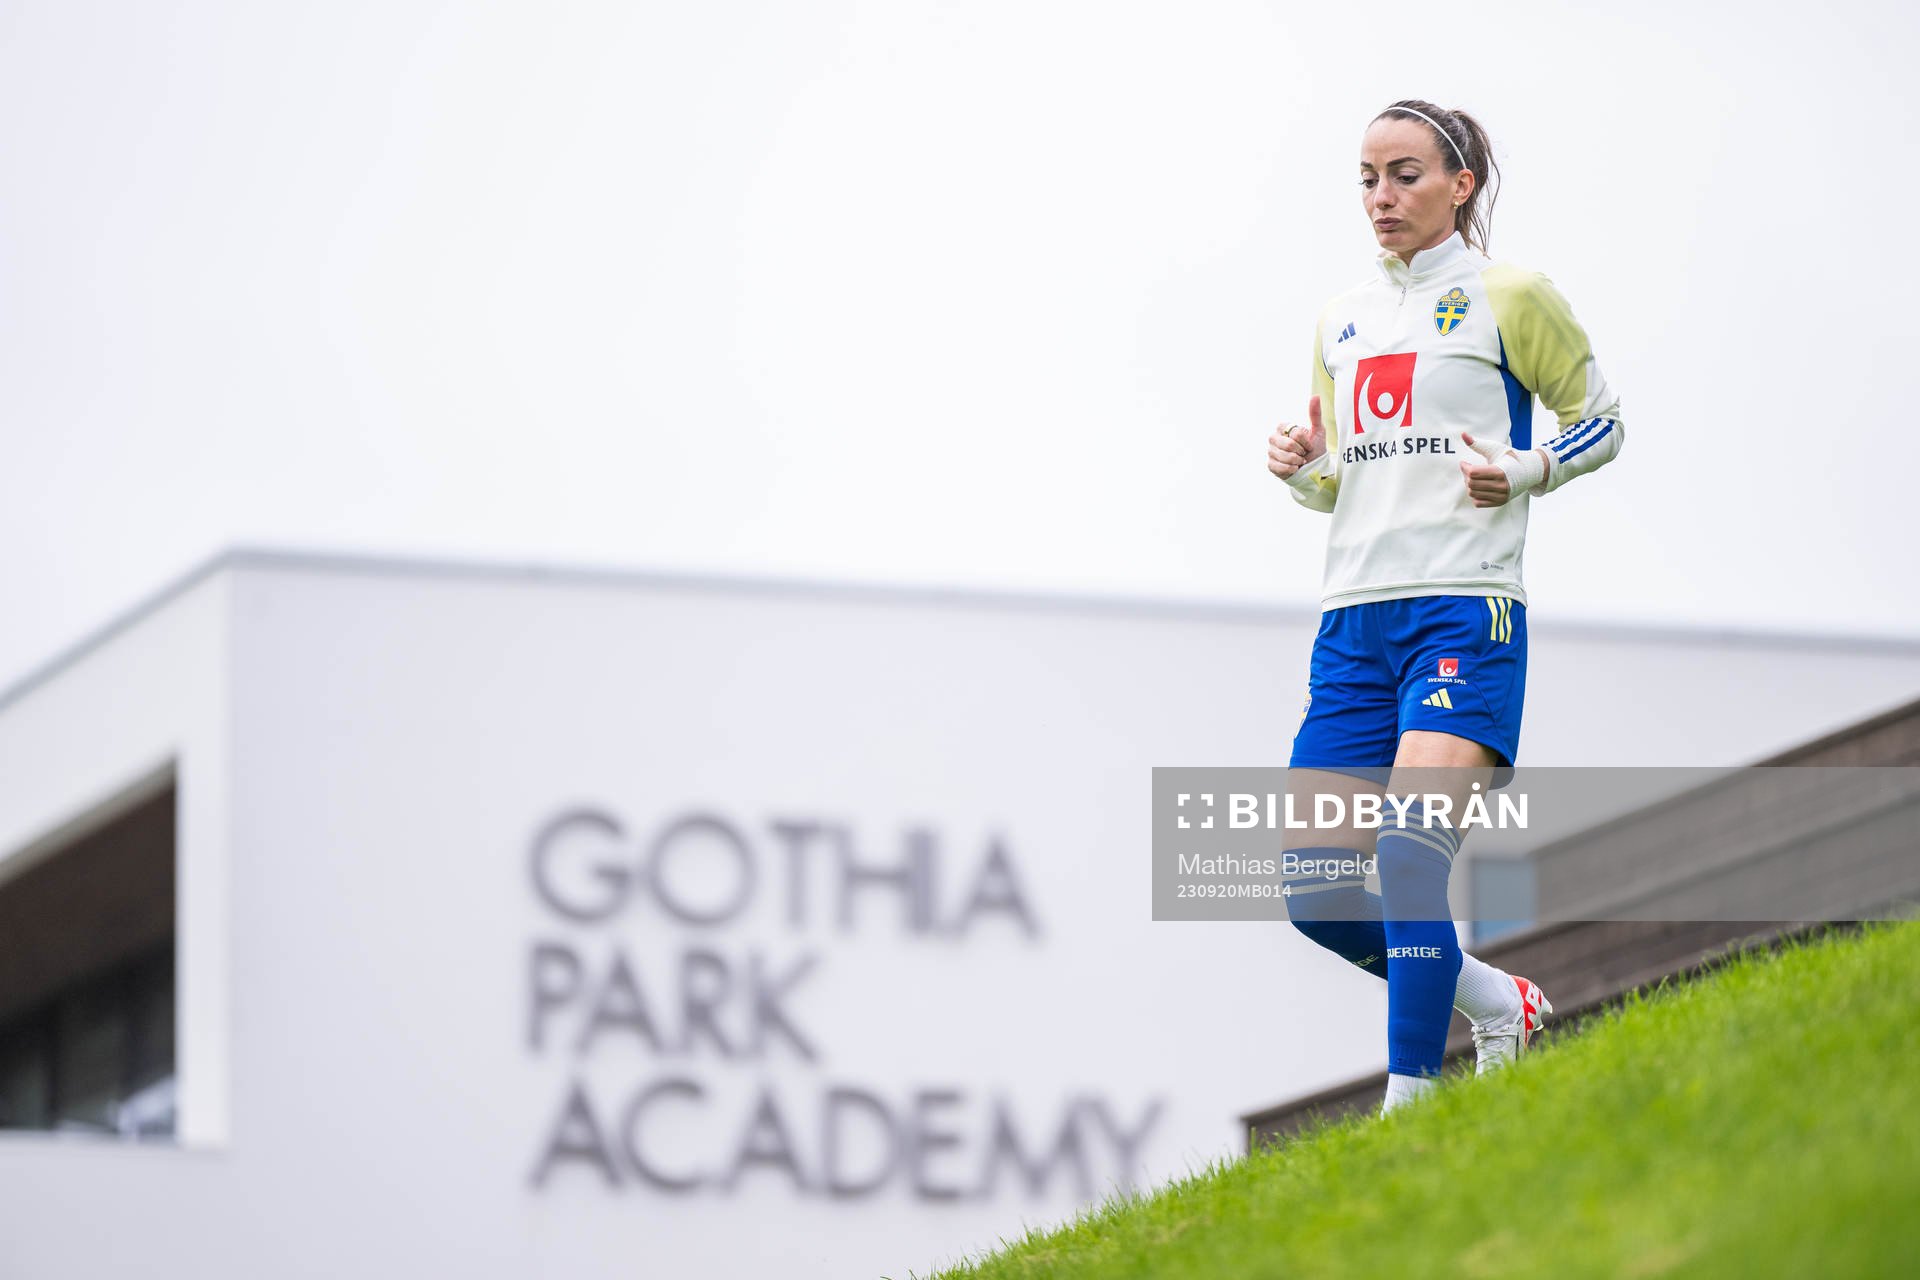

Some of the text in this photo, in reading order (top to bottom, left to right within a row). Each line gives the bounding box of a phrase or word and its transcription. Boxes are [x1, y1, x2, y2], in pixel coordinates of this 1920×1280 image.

[1403, 437, 1456, 455] SPEL
[526, 806, 1045, 944] GOTHIA
[526, 938, 822, 1066] PARK
[526, 1073, 1166, 1204] ACADEMY
